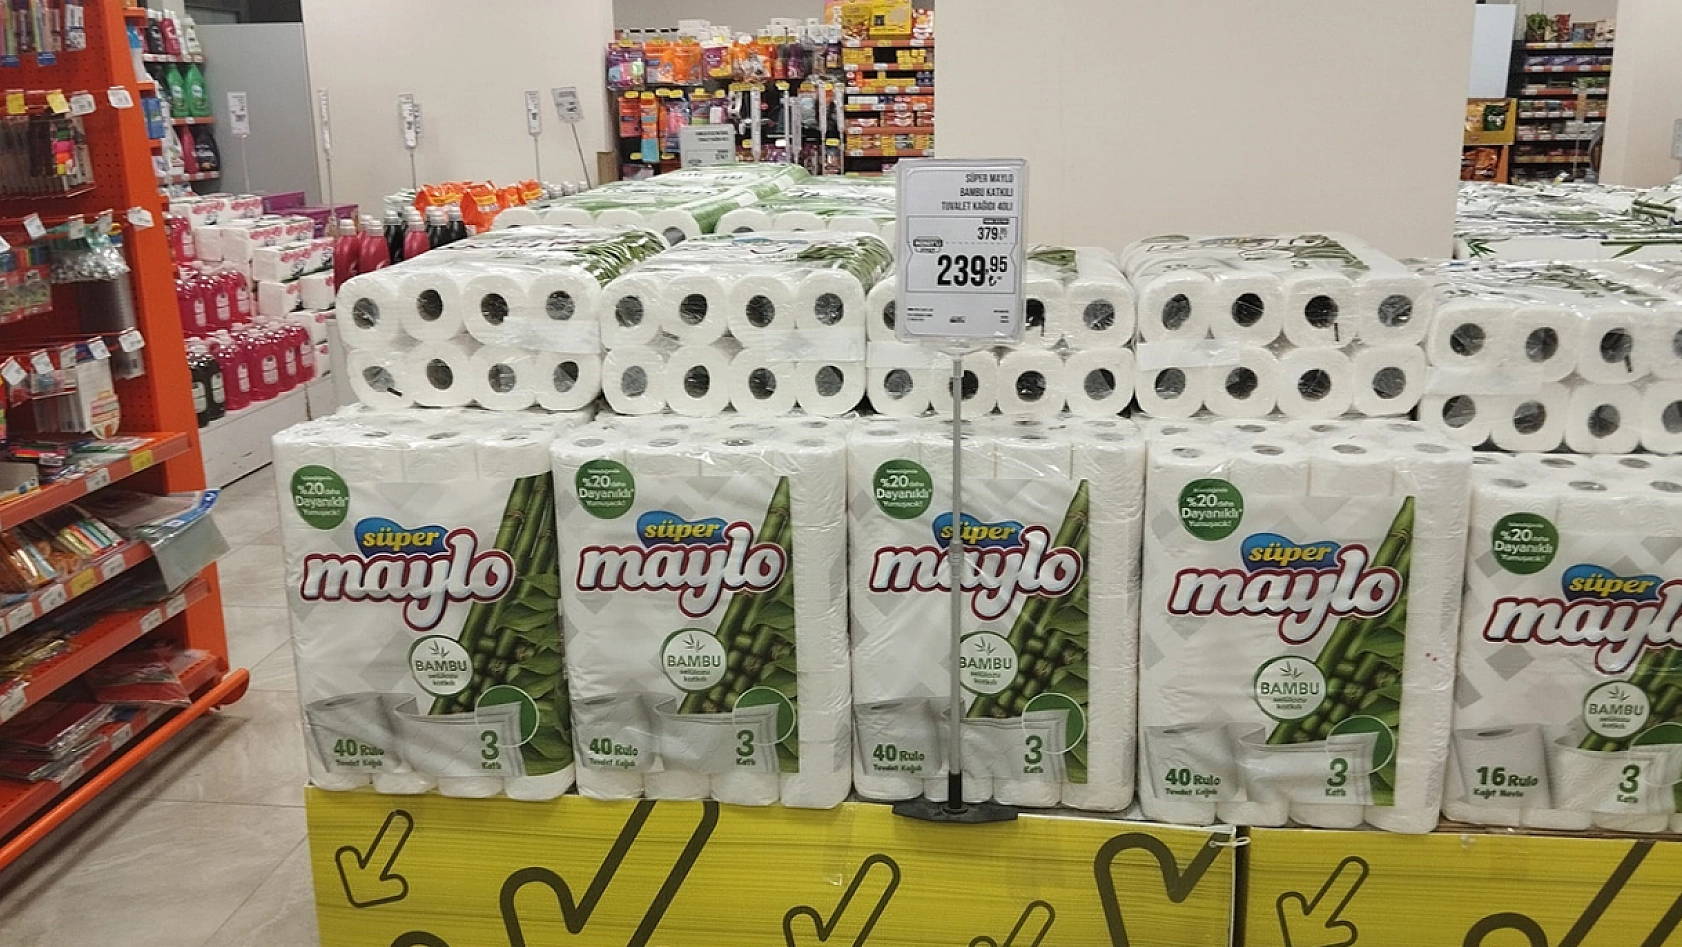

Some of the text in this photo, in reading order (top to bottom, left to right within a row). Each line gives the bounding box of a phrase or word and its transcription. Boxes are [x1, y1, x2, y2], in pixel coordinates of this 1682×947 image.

[362, 527, 439, 552] süper
[644, 519, 720, 541] süper
[1248, 543, 1331, 567] süper
[300, 528, 514, 631] maylo
[576, 522, 786, 618] maylo
[1167, 544, 1400, 645] maylo
[1569, 573, 1655, 598] süper
[416, 660, 467, 671] BAMBU
[667, 655, 721, 667] BAMBU
[959, 656, 1012, 669] BAMBU
[1260, 682, 1320, 695] BAMBU
[1588, 703, 1644, 716] BAMBU
[333, 739, 384, 756] 40 Rulo
[481, 730, 500, 760] 3
[589, 738, 638, 756] 40 Rulo
[736, 729, 754, 757] 3
[873, 743, 925, 761] 40 Rulo
[1024, 735, 1042, 764] 3
[1165, 768, 1221, 786] 40 Rulo
[1327, 757, 1348, 787] 3
[1476, 766, 1538, 787] 16 Rulo
[1619, 765, 1640, 794] 3
